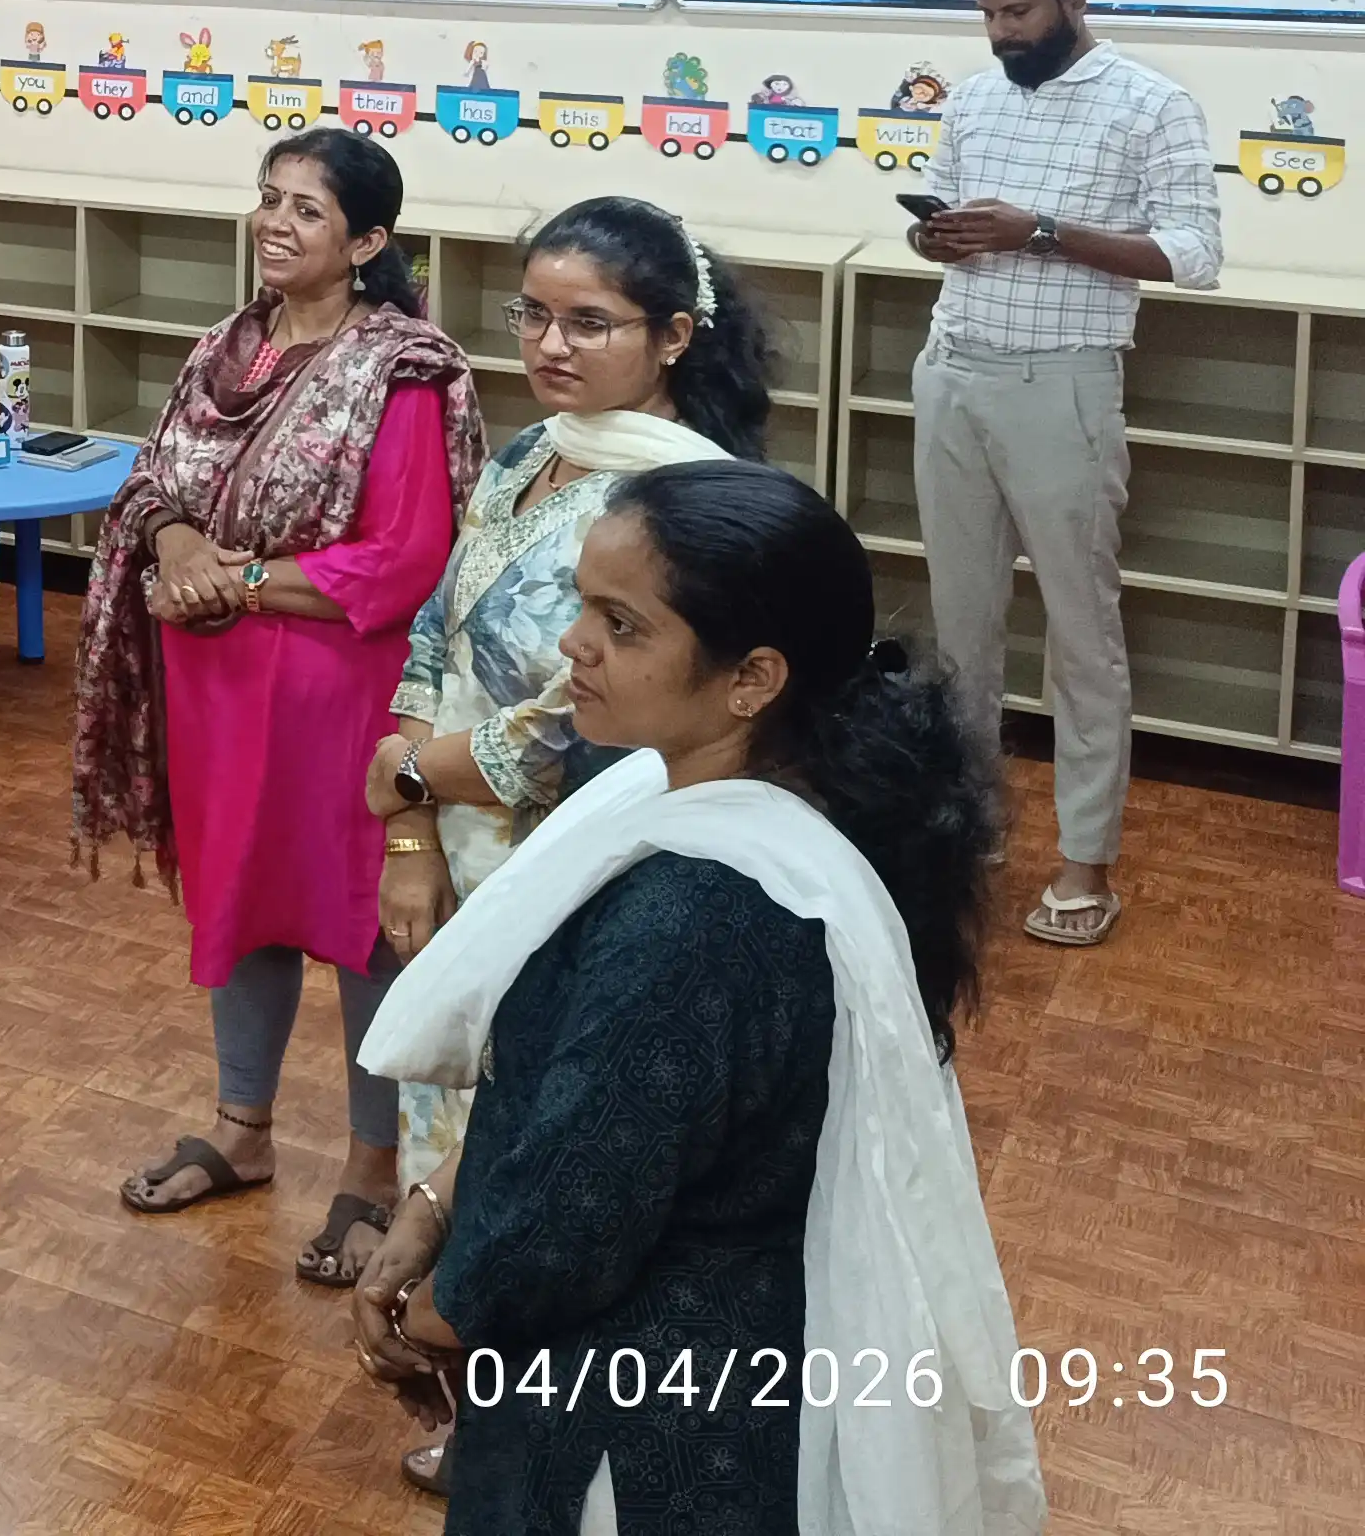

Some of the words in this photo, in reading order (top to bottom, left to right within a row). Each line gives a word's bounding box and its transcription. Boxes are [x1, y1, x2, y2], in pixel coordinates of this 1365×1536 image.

[16, 75, 46, 91] you
[93, 79, 128, 99] they
[180, 87, 215, 105] and
[268, 88, 302, 107] him
[354, 93, 398, 112] their
[462, 105, 494, 122] has
[561, 109, 600, 127] this
[875, 123, 930, 145] with
[1273, 151, 1316, 171] See
